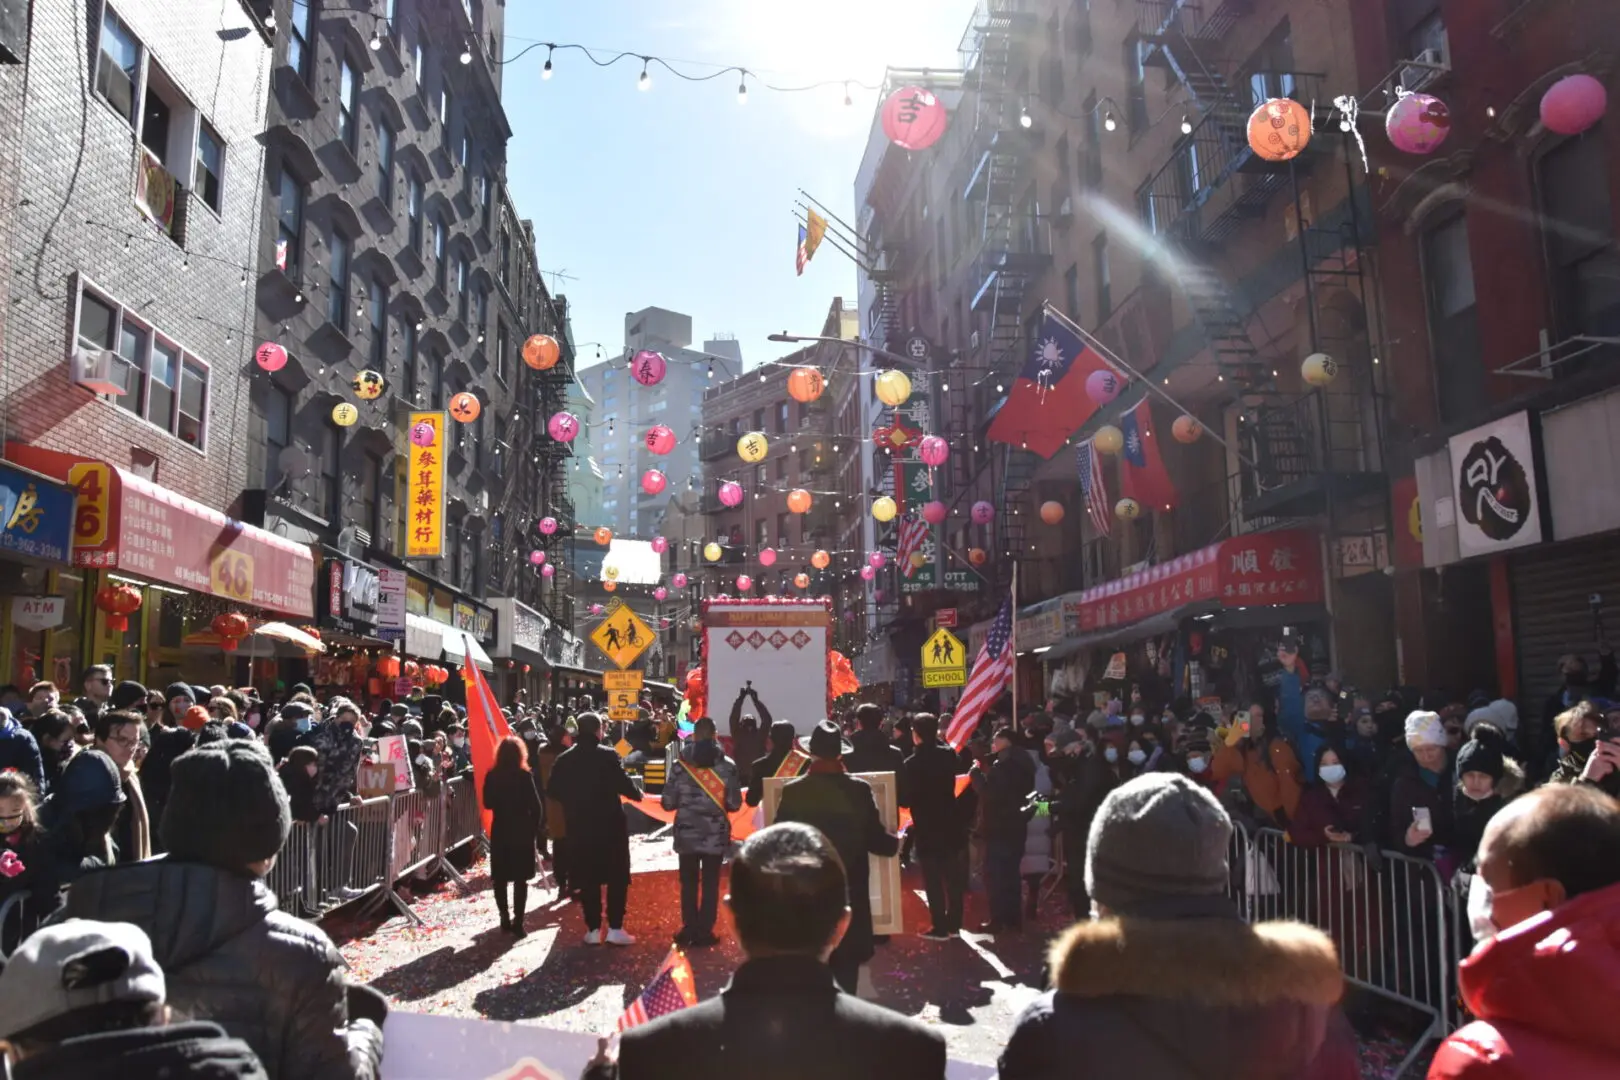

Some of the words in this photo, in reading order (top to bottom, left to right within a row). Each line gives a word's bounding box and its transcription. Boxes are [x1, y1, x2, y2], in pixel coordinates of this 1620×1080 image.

[898, 93, 927, 124] 吉
[337, 406, 349, 420] 吉
[647, 430, 659, 446] 吉
[745, 439, 760, 456] 吉
[414, 417, 437, 543] 參茸藥材行
[218, 554, 248, 596] 46
[23, 601, 54, 614] ATM
[926, 671, 963, 683] SCHOOL
[618, 694, 629, 709] 5
